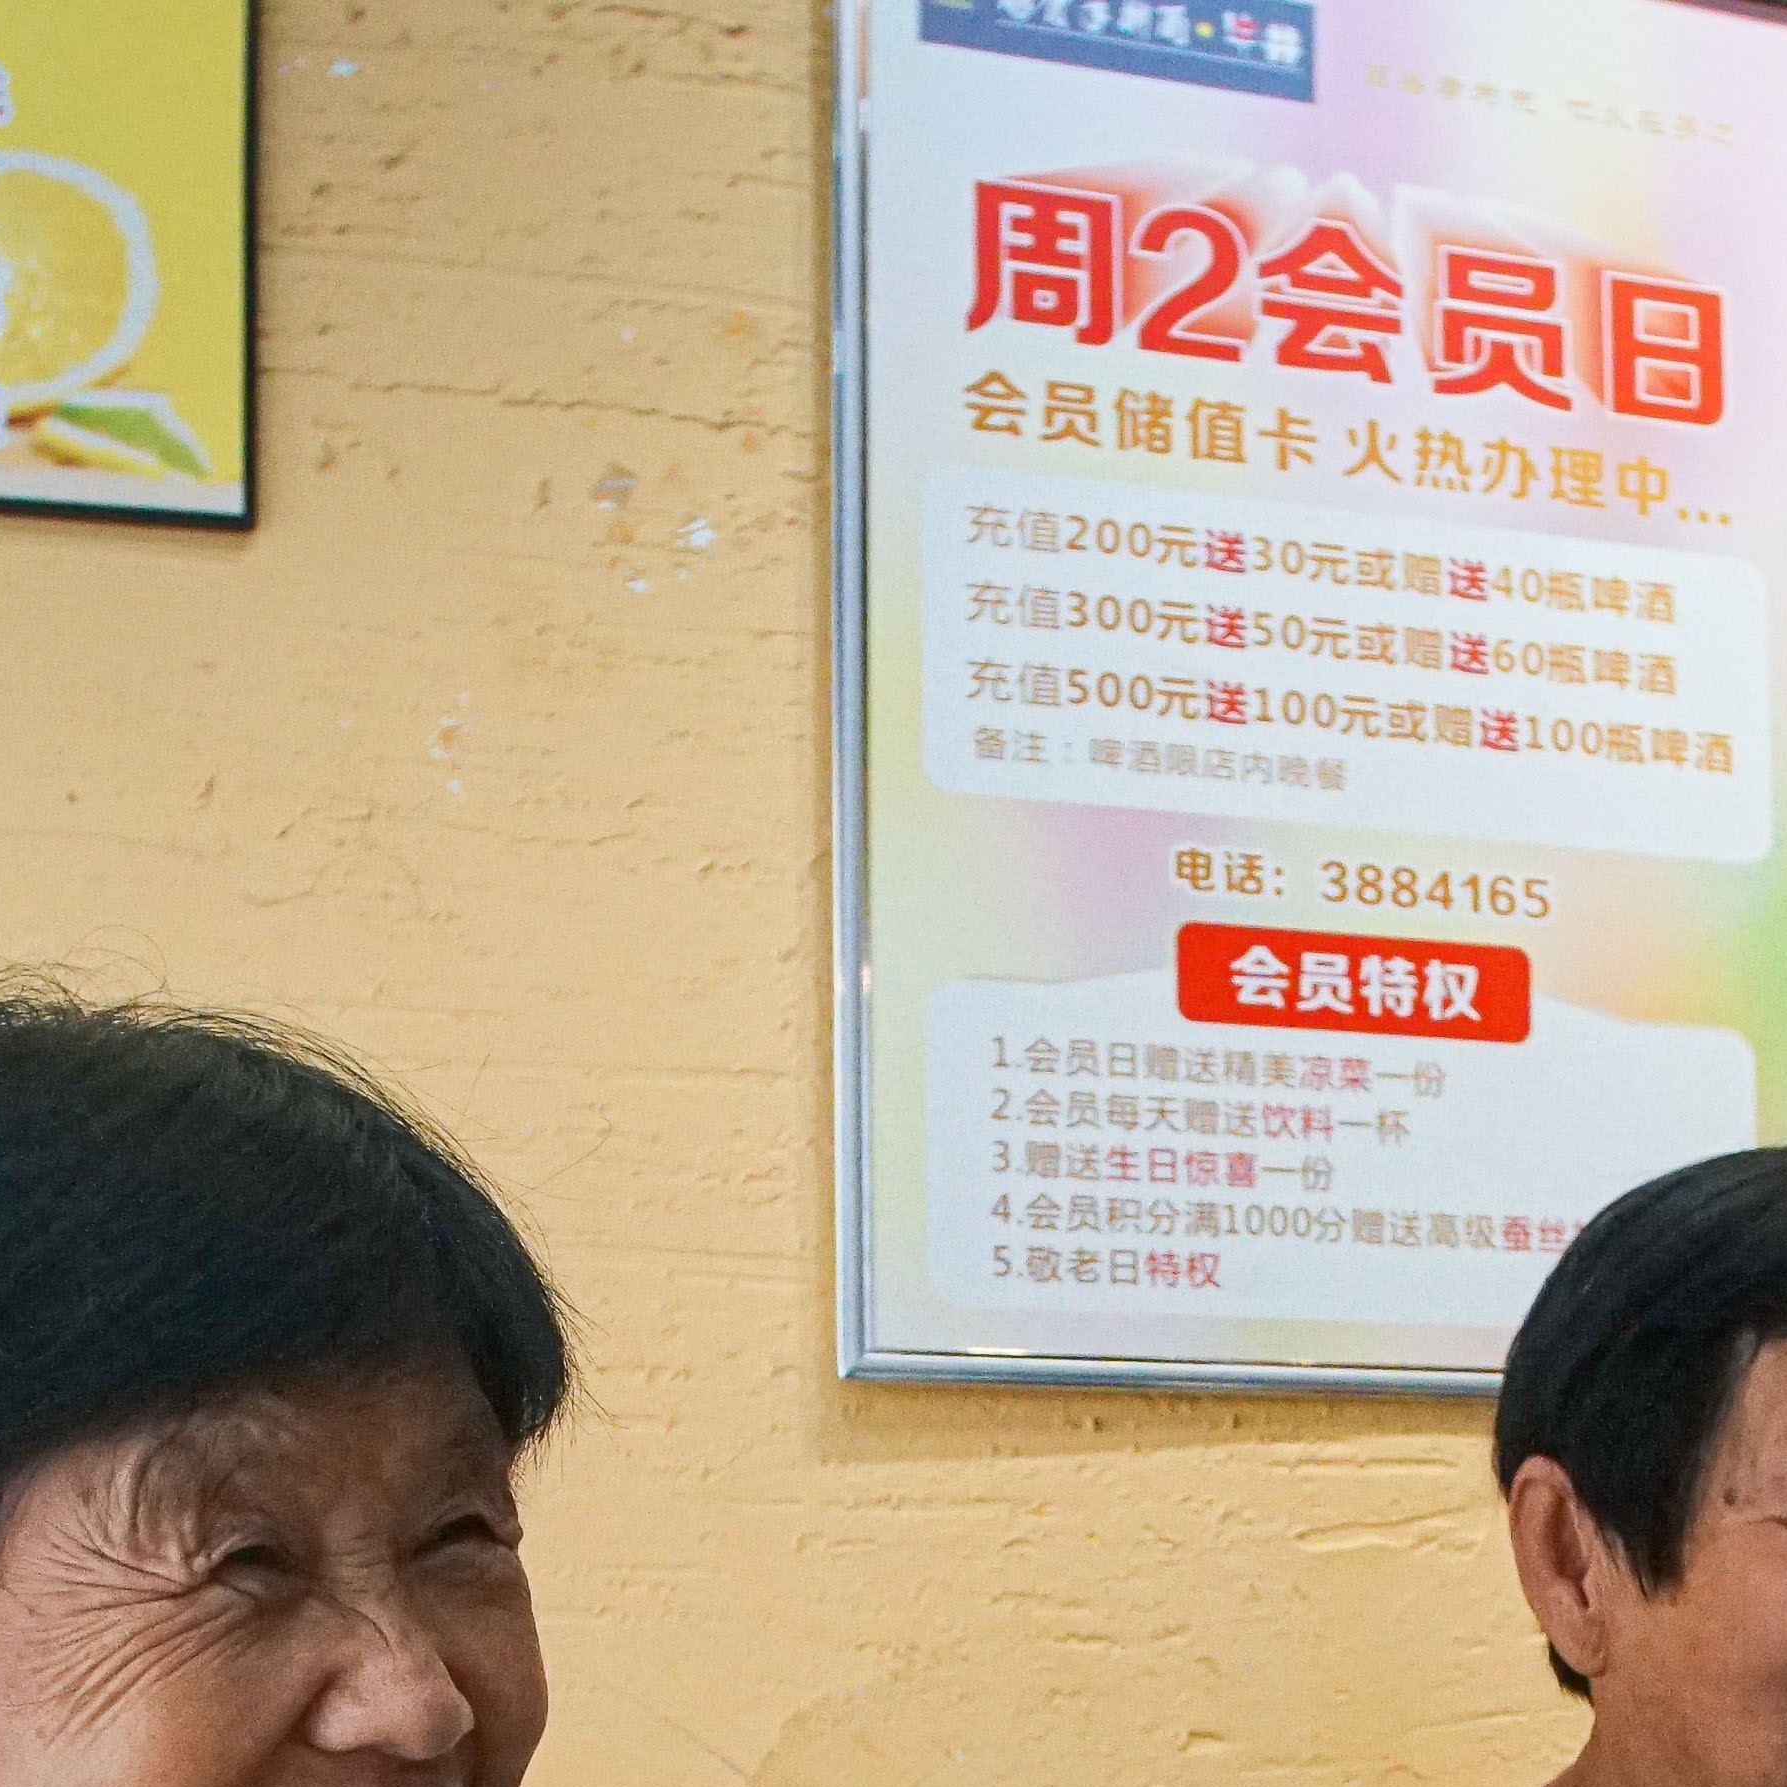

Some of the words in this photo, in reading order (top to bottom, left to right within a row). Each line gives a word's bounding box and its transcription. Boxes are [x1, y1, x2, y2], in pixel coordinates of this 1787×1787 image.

[966, 178, 1726, 426] 周2会员日
[964, 369, 1317, 470] 会员储值卡
[966, 504, 1676, 624] 充值200元送30元或赠送40瓶啤酒
[966, 580, 1677, 697] 充值300元送50元或赠送60瓶啤酒
[966, 656, 1734, 776] 充值500元送100元或赠送100瓶啤酒
[1229, 944, 1480, 1024] 会员特权
[989, 1193, 1583, 1255] 4.会员积分满1000分赠送高级蚕丝
[989, 1245, 1223, 1291] 5.敬老日特权
